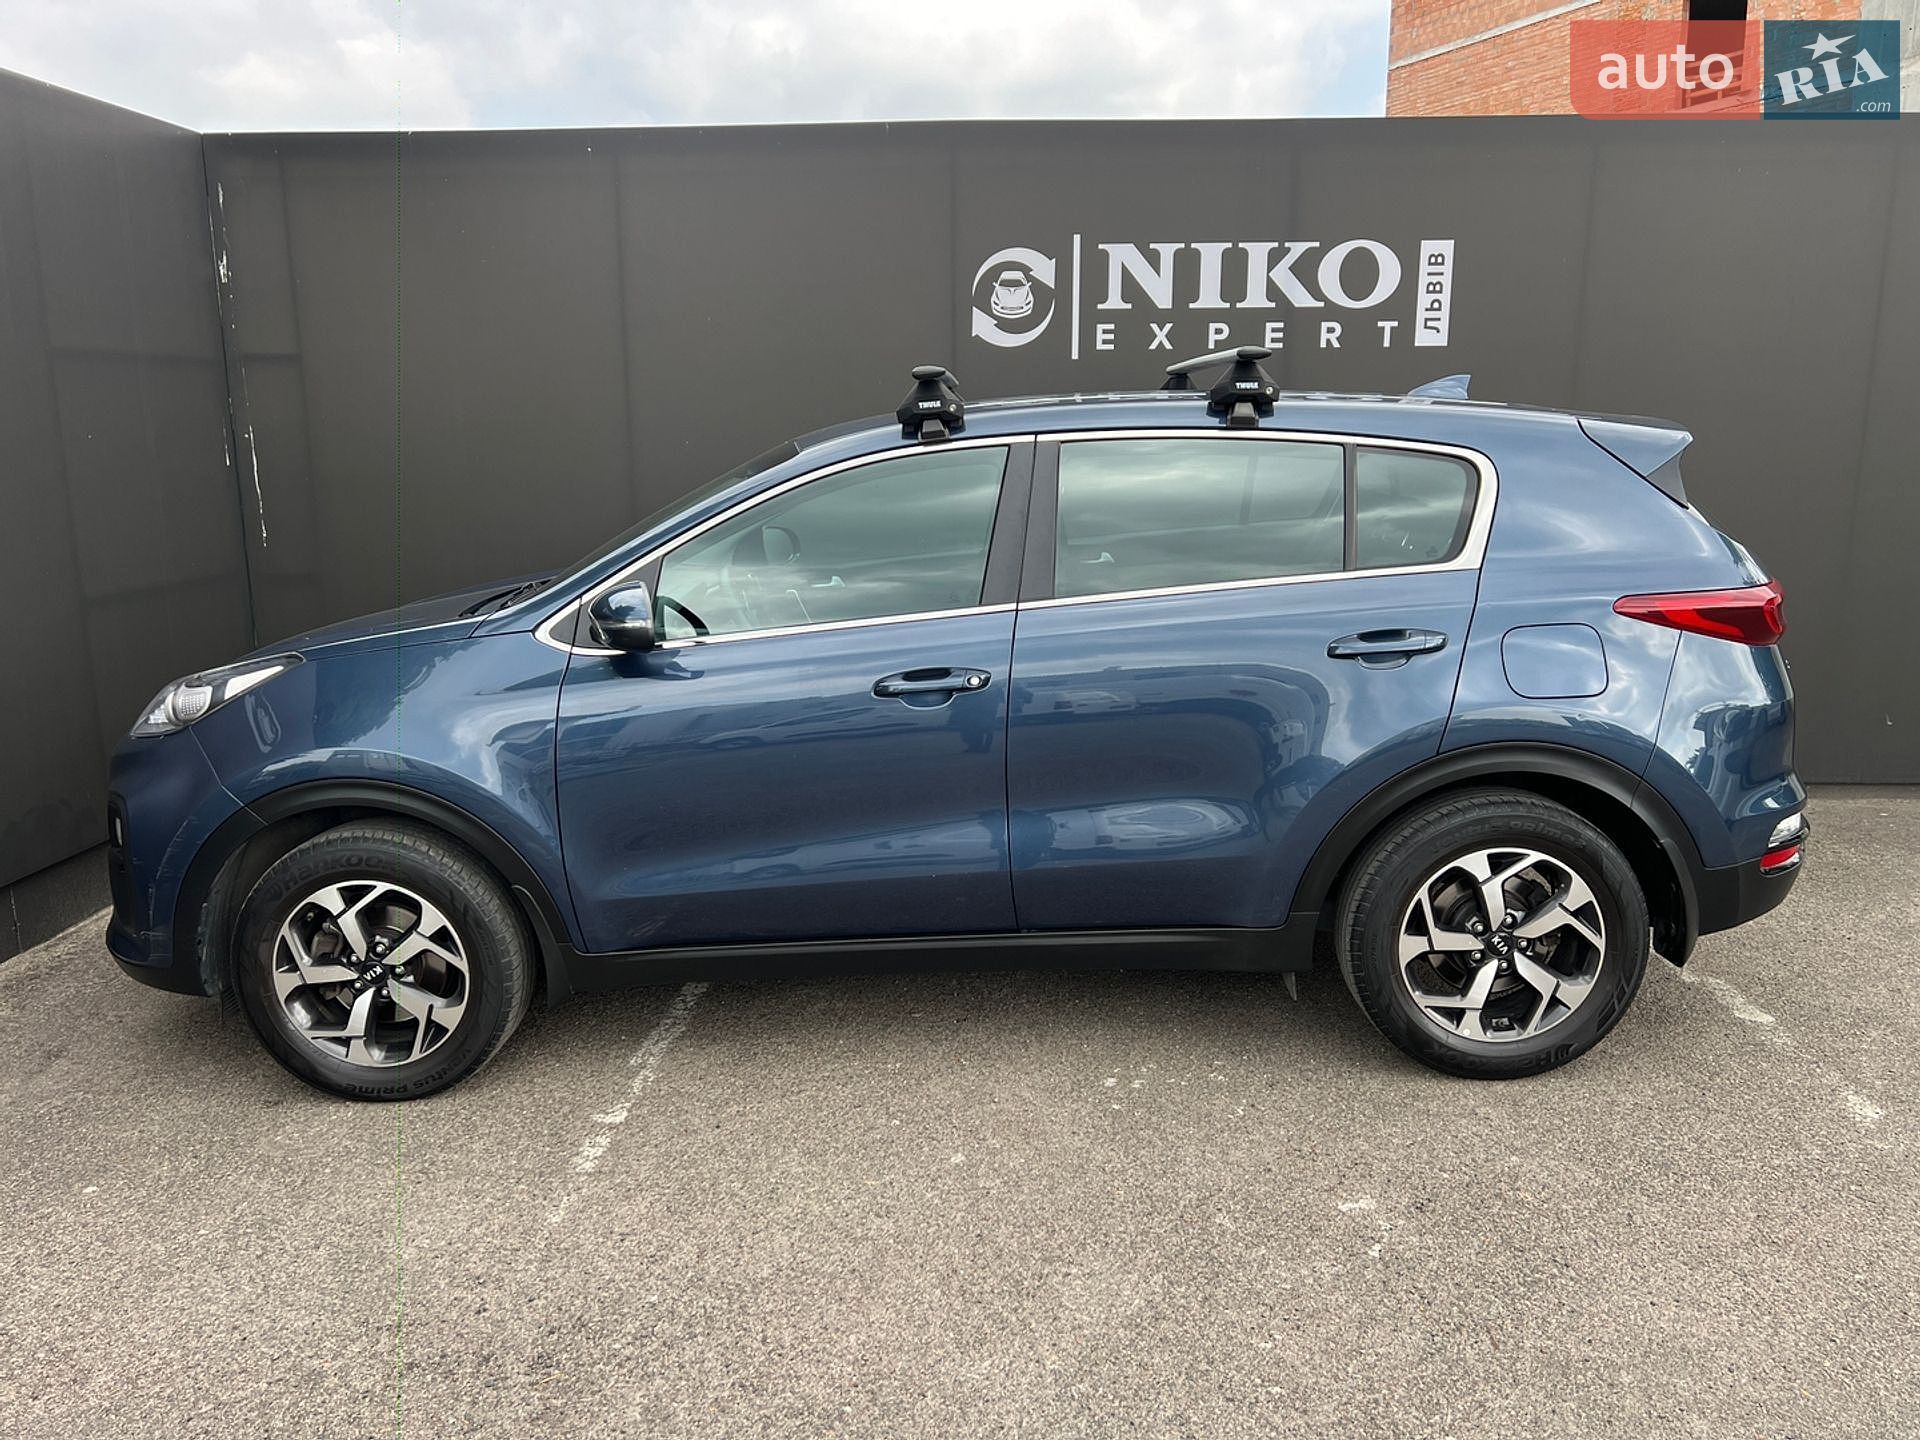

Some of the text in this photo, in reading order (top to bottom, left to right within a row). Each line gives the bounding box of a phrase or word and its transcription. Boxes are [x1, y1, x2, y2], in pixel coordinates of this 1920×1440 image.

[1097, 239, 1402, 309] NIKO
[1423, 252, 1446, 333] ЛЬВІВ
[1096, 320, 1399, 350] EXPERT
[1235, 381, 1259, 390] THULE
[918, 400, 941, 409] THULE
[1491, 935, 1508, 955] KIA
[363, 965, 383, 980] KIA
